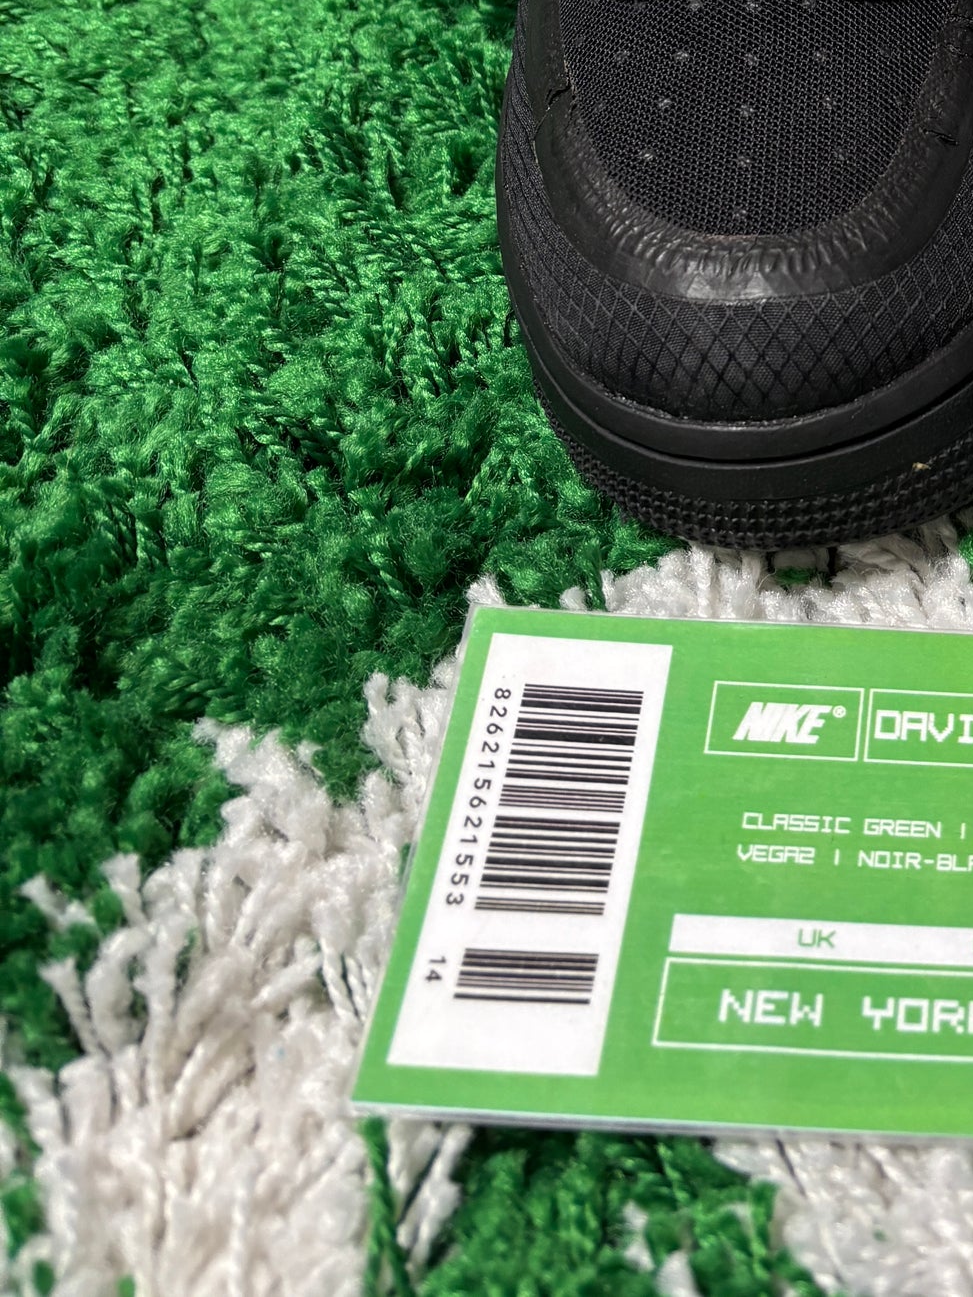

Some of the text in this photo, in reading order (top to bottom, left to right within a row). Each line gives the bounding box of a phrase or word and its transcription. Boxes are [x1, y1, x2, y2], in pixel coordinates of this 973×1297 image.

[742, 811, 851, 835] CLASSIC
[863, 818, 942, 839] GREEN
[797, 928, 836, 949] UK
[718, 988, 824, 1028] NEW
